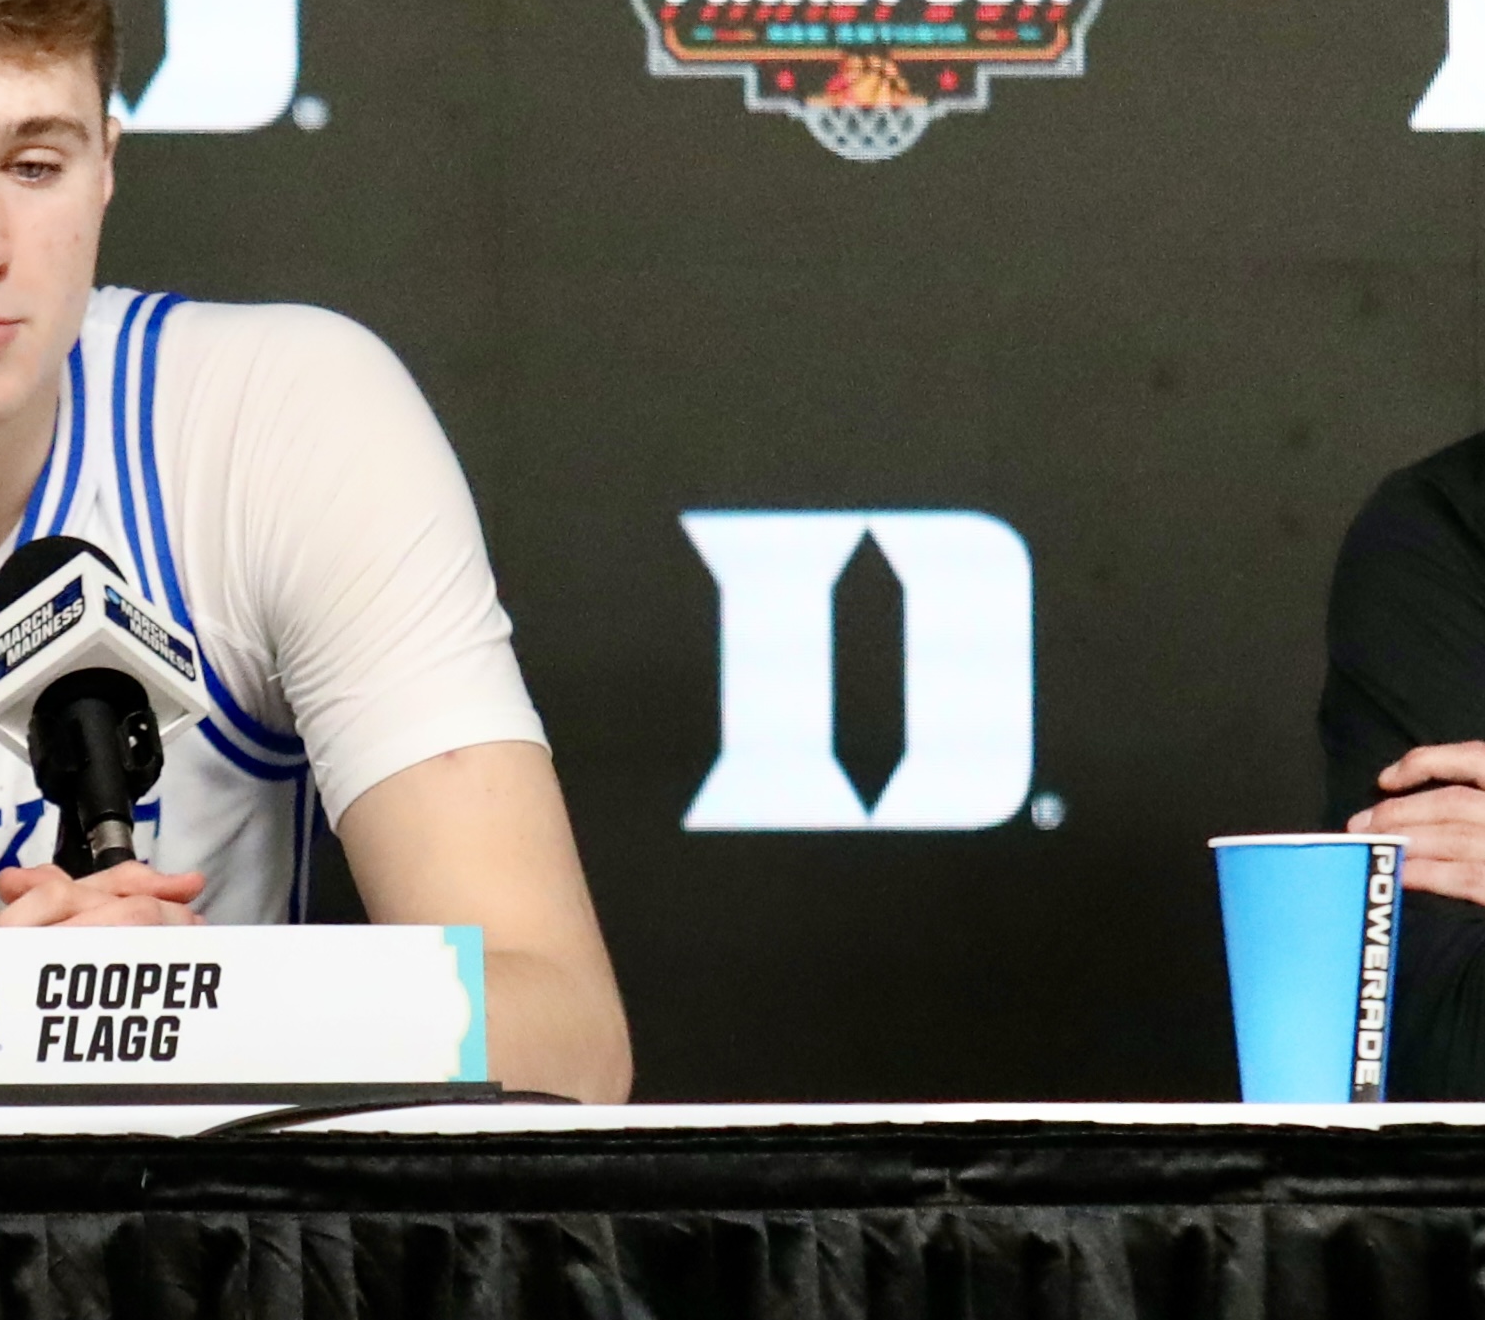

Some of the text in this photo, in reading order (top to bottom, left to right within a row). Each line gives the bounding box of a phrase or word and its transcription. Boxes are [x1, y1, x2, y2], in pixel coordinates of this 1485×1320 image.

[5, 597, 85, 668] MADNESS
[678, 509, 1036, 831] D
[35, 963, 222, 1010] COOPER
[1354, 845, 1397, 1085] POWERADE
[36, 1015, 182, 1063] FLAGG
